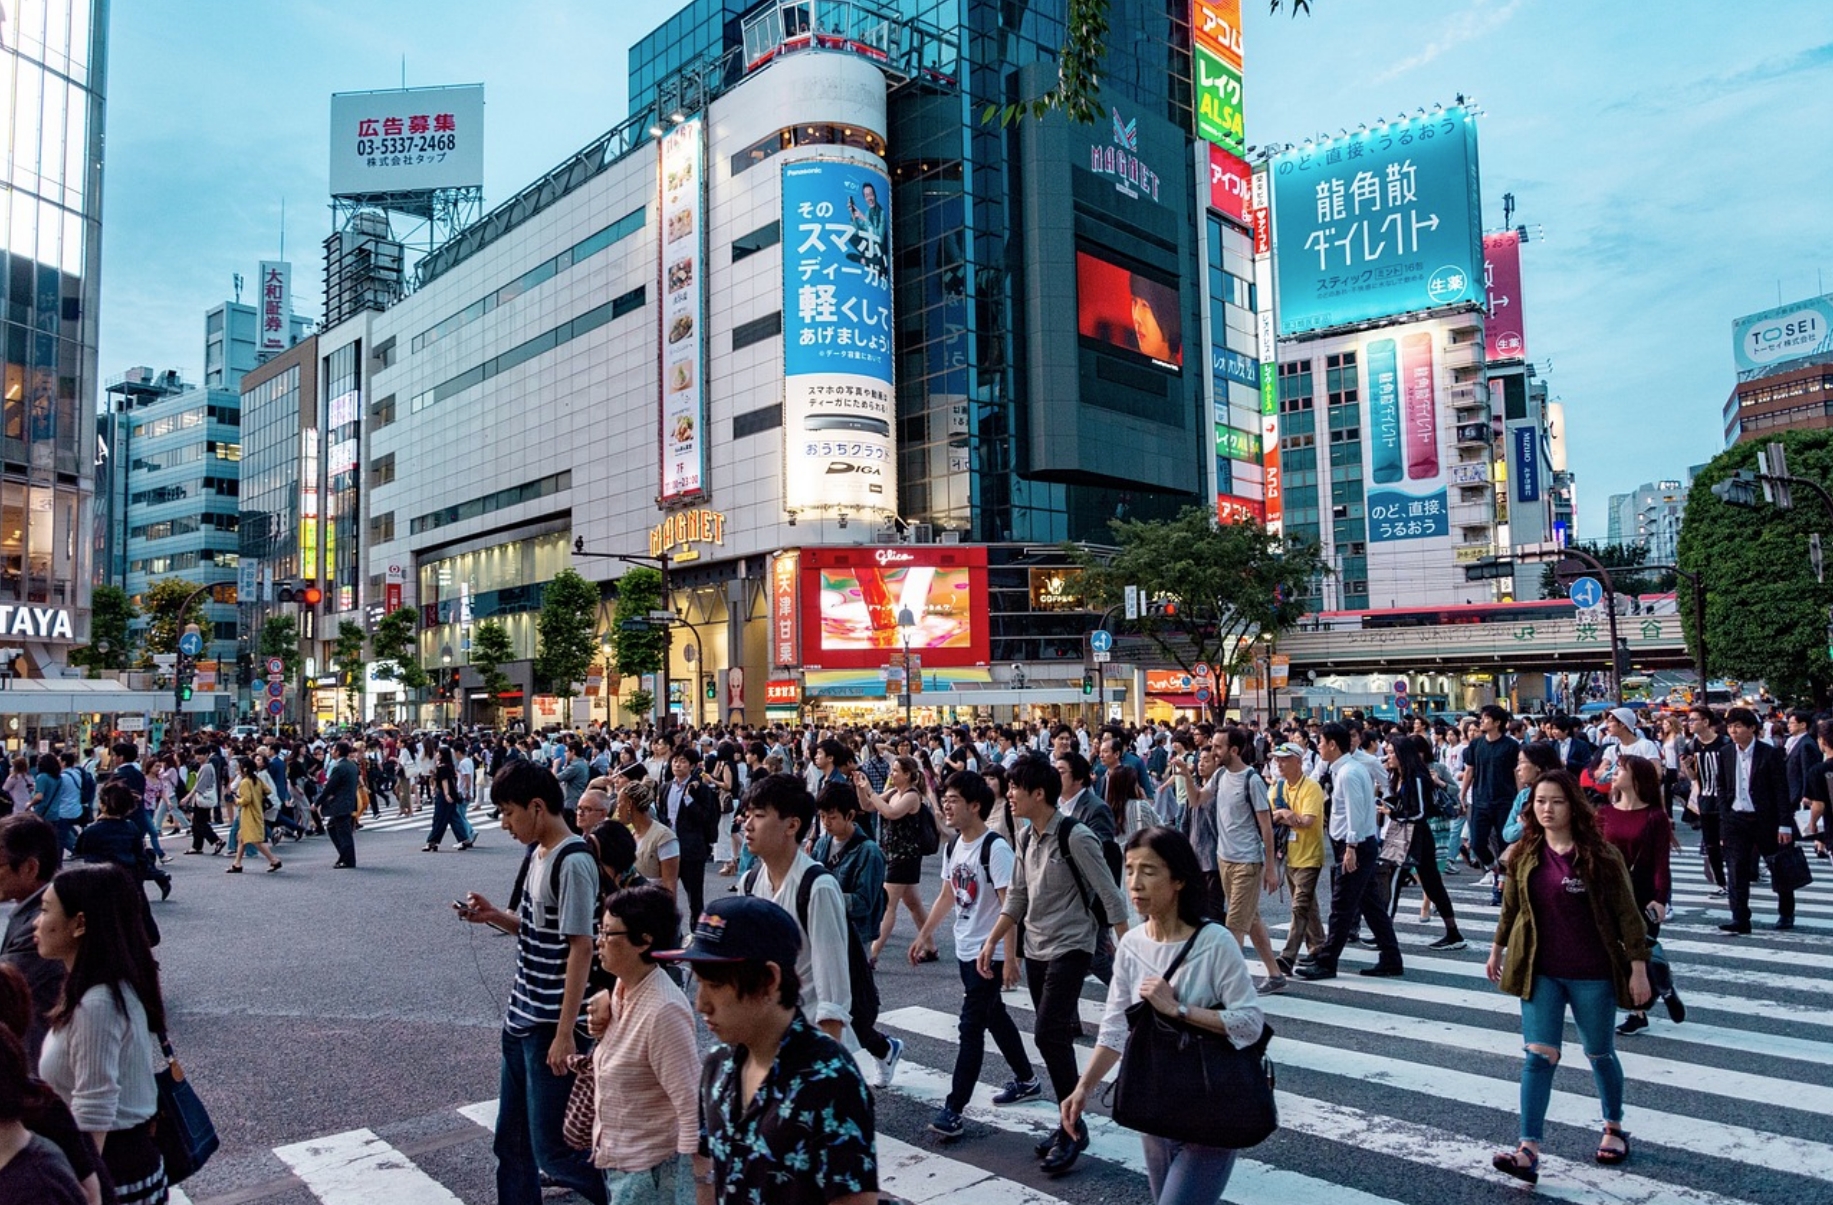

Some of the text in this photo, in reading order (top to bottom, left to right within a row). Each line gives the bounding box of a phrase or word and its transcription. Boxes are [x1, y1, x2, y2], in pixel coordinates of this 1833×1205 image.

[1200, 58, 1241, 105] レイク
[358, 113, 456, 138] 広告募集
[1200, 93, 1243, 137] ALSA
[356, 133, 456, 157] 03-5337-2468
[366, 152, 447, 168] 株式会社タップ
[1278, 117, 1456, 176] のど、直接、うるおう
[786, 167, 823, 177] Panasonic
[1091, 143, 1160, 203] MAGNET
[1210, 162, 1251, 201] アイフル
[1316, 158, 1418, 224] 龍角散
[797, 201, 834, 219] その
[1304, 209, 1441, 271] ダイレクト
[797, 256, 889, 292] ディーガが
[1316, 269, 1373, 292] スティック
[1430, 273, 1467, 296] 生薬
[264, 267, 283, 332] 大和証券
[797, 283, 889, 332] 軽くして
[1751, 317, 1816, 345] TOSEI
[1213, 352, 1257, 382] レオパレス21
[1216, 431, 1238, 447] レイク
[1266, 467, 1278, 498] アコム
[1371, 498, 1447, 520] のど、直接、
[650, 509, 726, 557] MAGNET
[1379, 518, 1436, 539] うるおう
[875, 549, 914, 566] Glico
[0, 605, 74, 638] TAYA
[779, 575, 793, 663] 天津甘栗
[1513, 626, 1536, 640] JR
[767, 685, 796, 698] 天津甘栗
